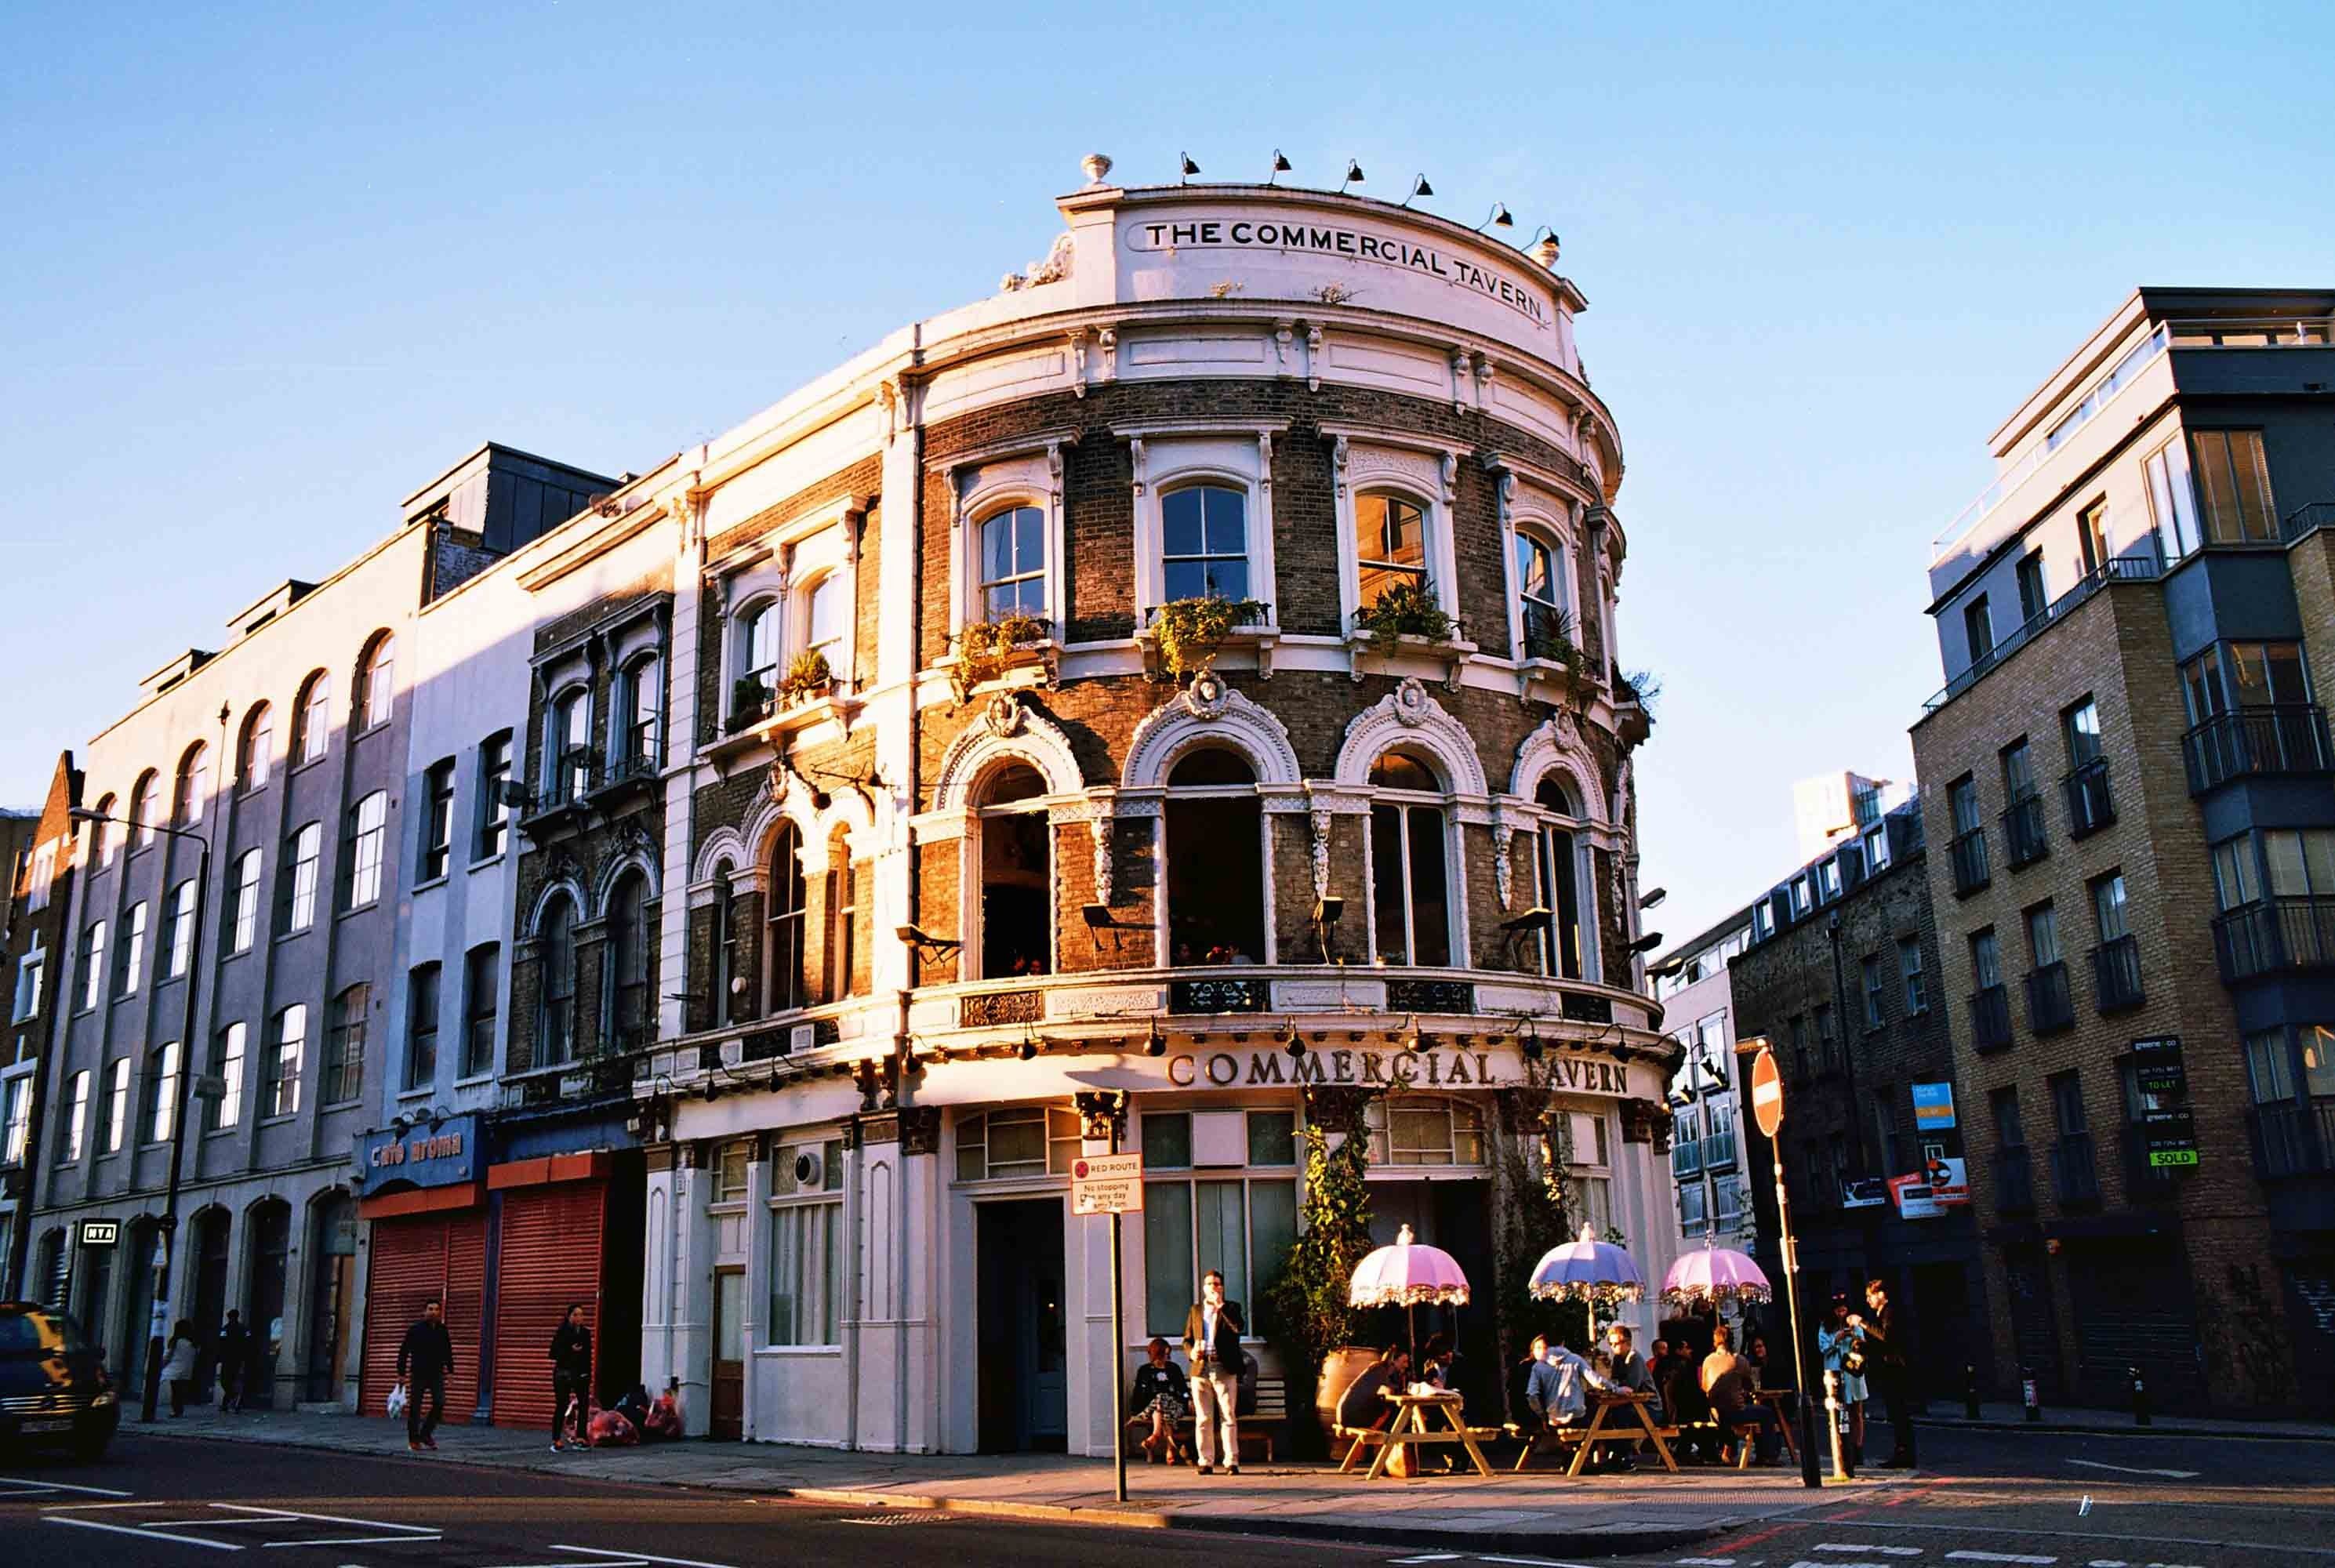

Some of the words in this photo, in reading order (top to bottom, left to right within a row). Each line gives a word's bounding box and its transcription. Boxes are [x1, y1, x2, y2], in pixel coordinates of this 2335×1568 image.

[1146, 222, 1222, 245] THE
[1231, 222, 1447, 276] COMMERCIAL
[1454, 260, 1542, 320] TAVERN
[1167, 1049, 1495, 1087] COMMERCIAL
[1091, 1164, 1108, 1173] RED
[1109, 1162, 1138, 1172] ROUTE
[2157, 1152, 2191, 1163] SOLD
